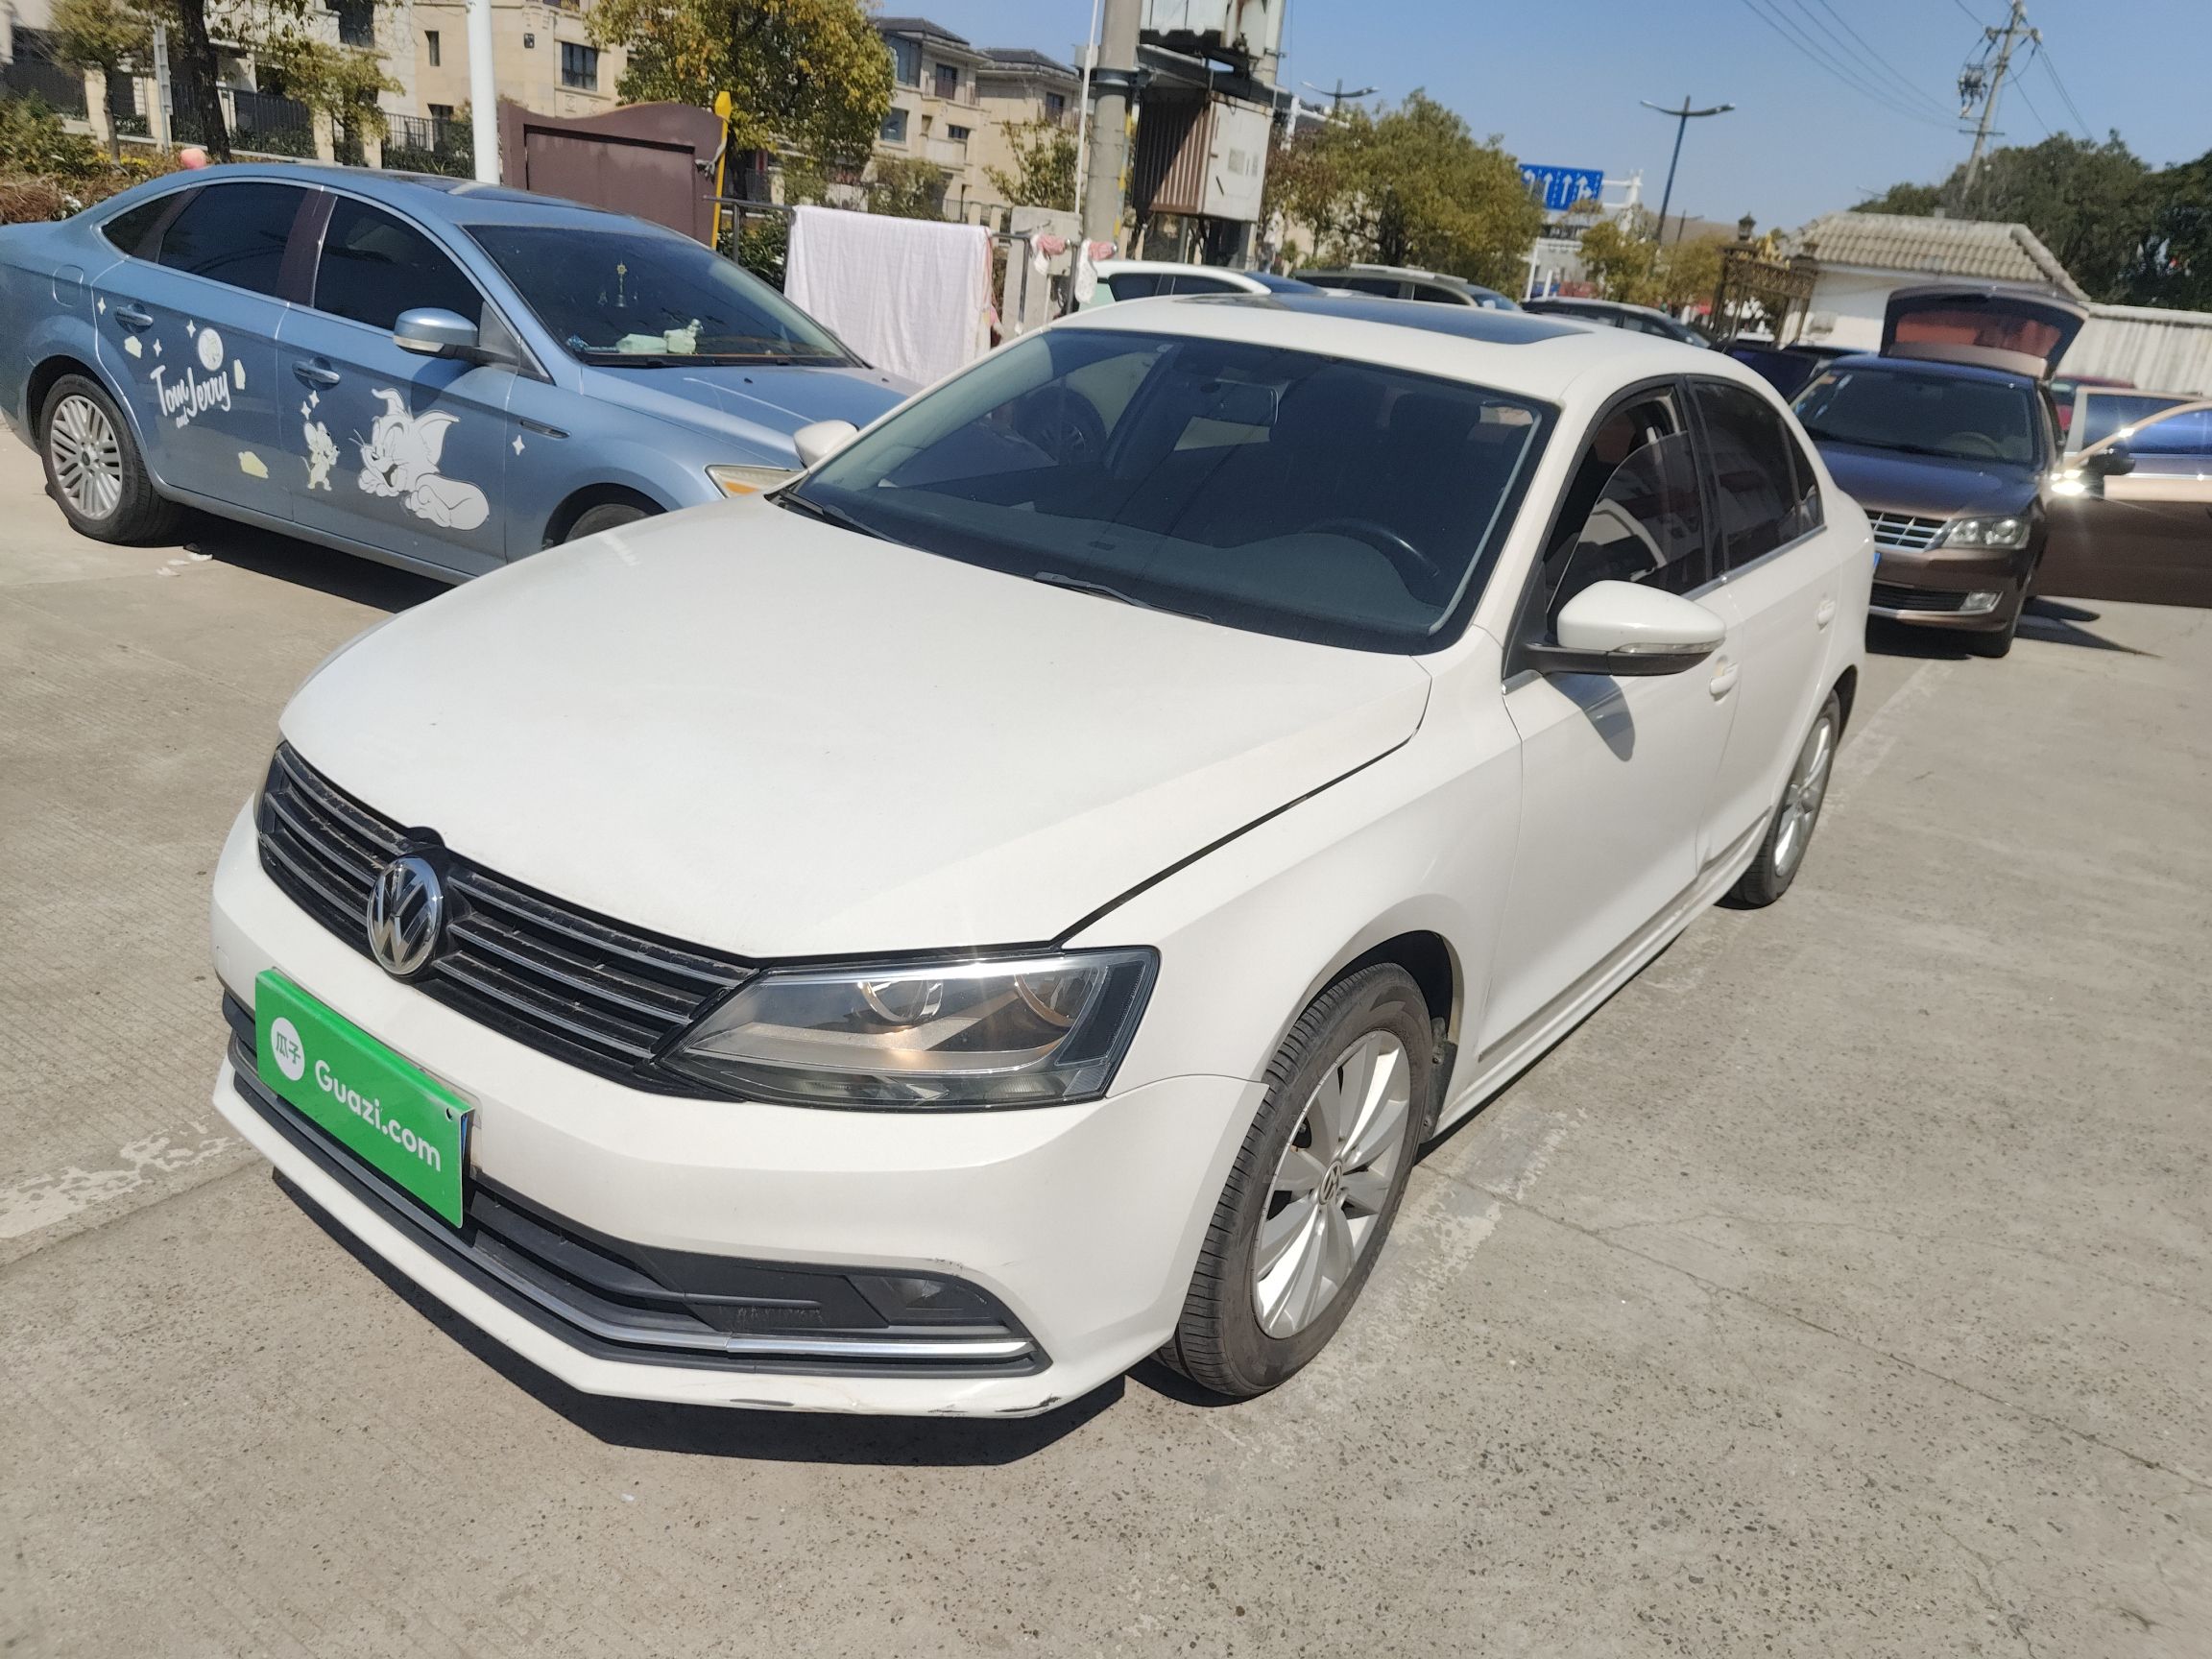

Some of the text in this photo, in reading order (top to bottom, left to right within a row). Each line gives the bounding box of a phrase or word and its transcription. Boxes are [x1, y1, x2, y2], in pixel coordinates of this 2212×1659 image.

[150, 365, 230, 418] Tom Jerry
[176, 405, 190, 429] and
[275, 1031, 301, 1066] 瓜子
[314, 1059, 442, 1172] Guazi.com
